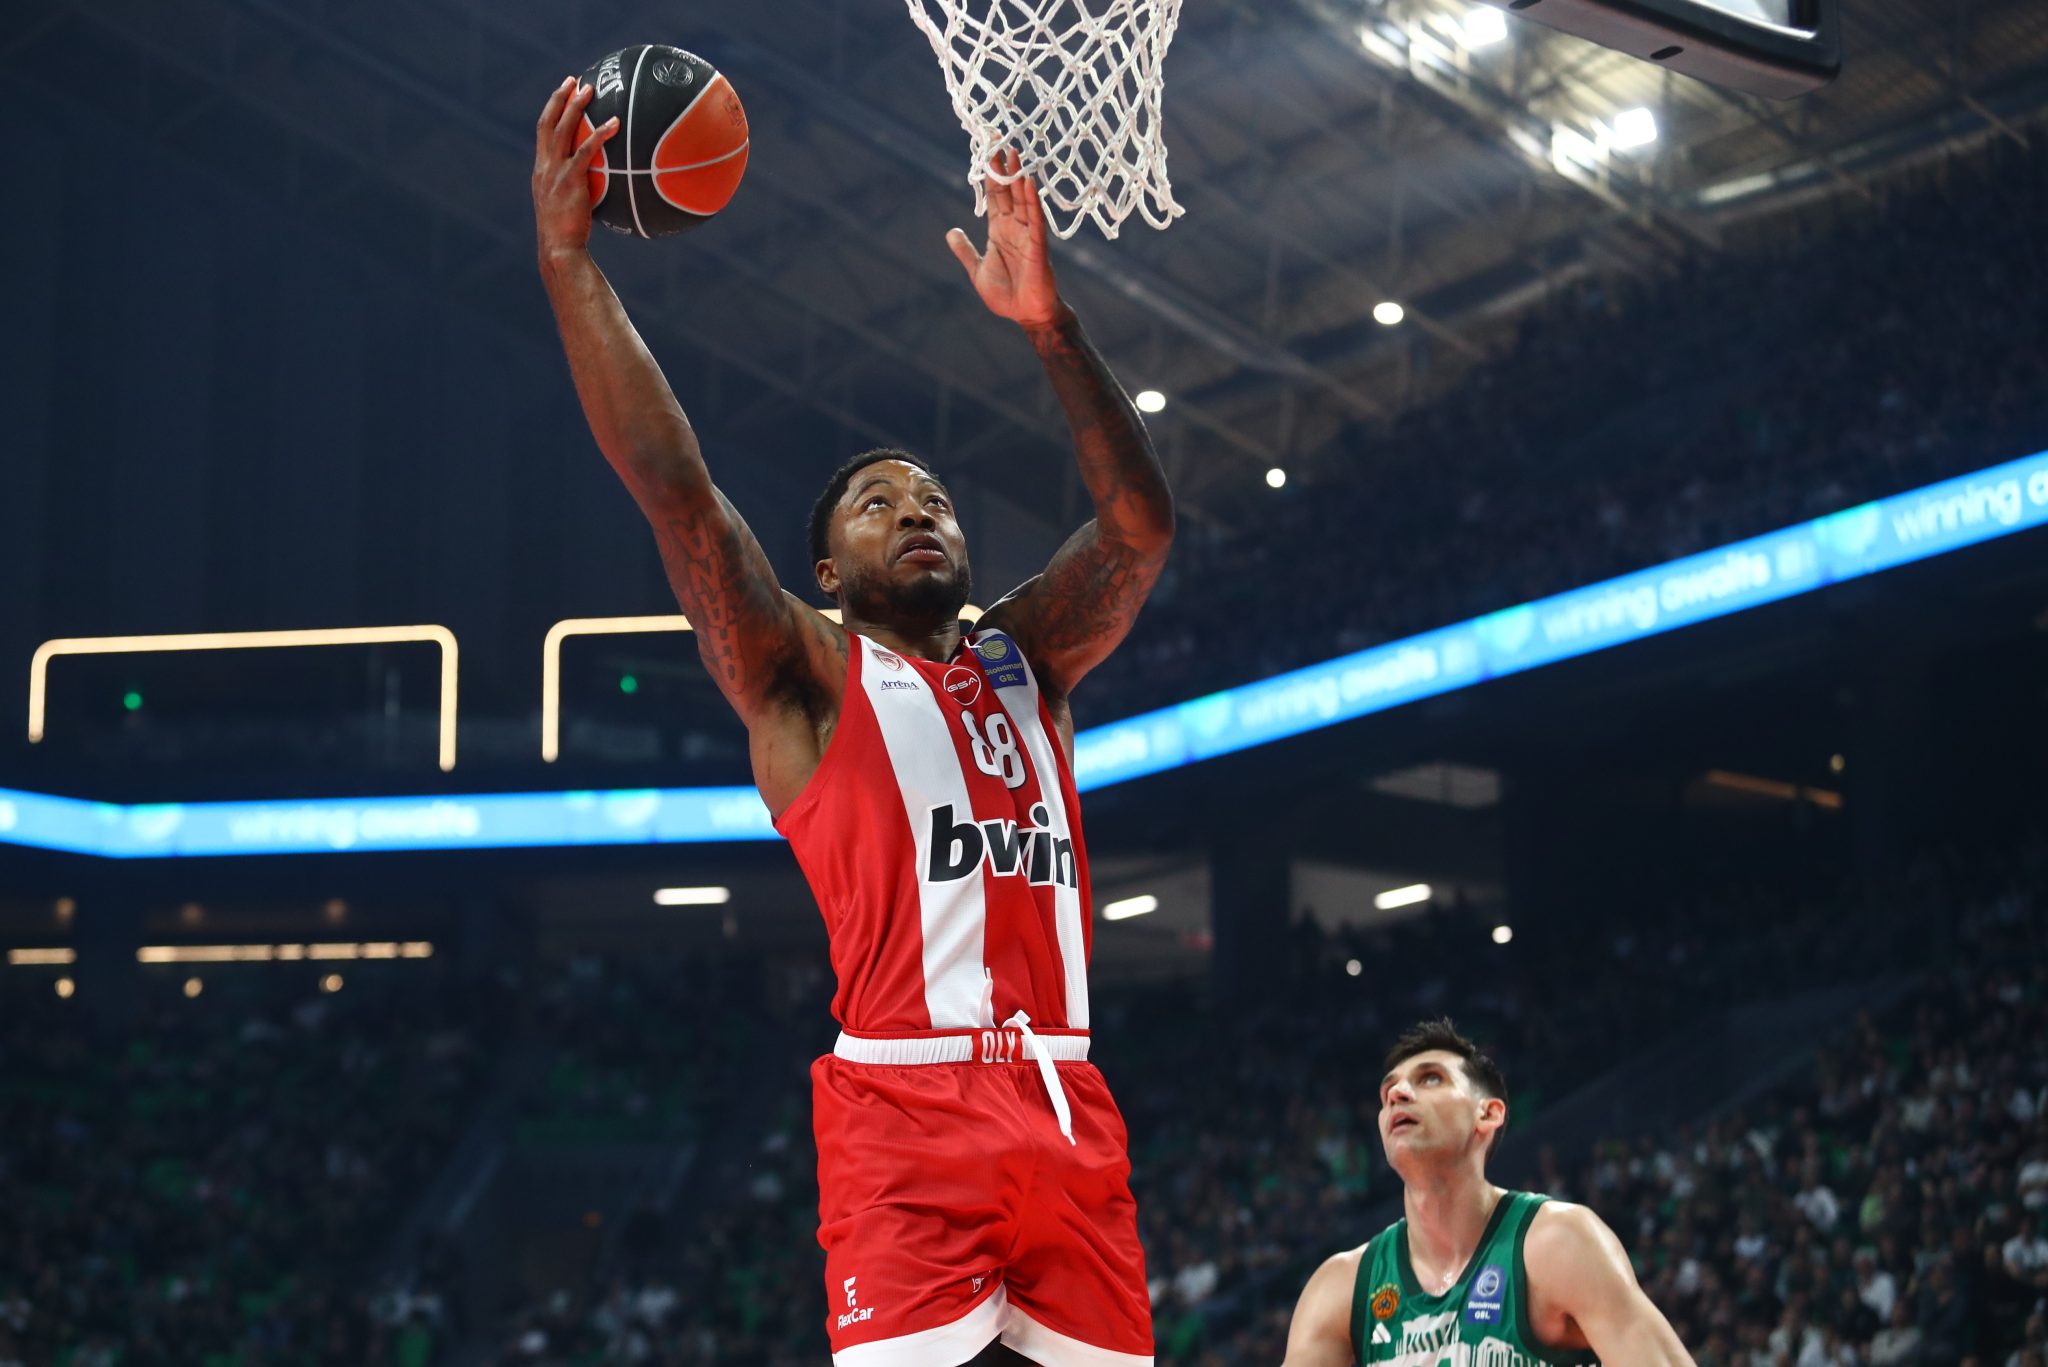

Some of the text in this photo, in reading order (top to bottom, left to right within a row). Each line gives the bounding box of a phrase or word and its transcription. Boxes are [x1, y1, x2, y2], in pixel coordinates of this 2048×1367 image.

[946, 676, 978, 693] GSA
[998, 673, 1019, 683] GBL
[961, 710, 1026, 789] 88
[927, 803, 1078, 889] bwin
[981, 1031, 1016, 1064] OLY
[837, 1307, 874, 1331] FlexCar
